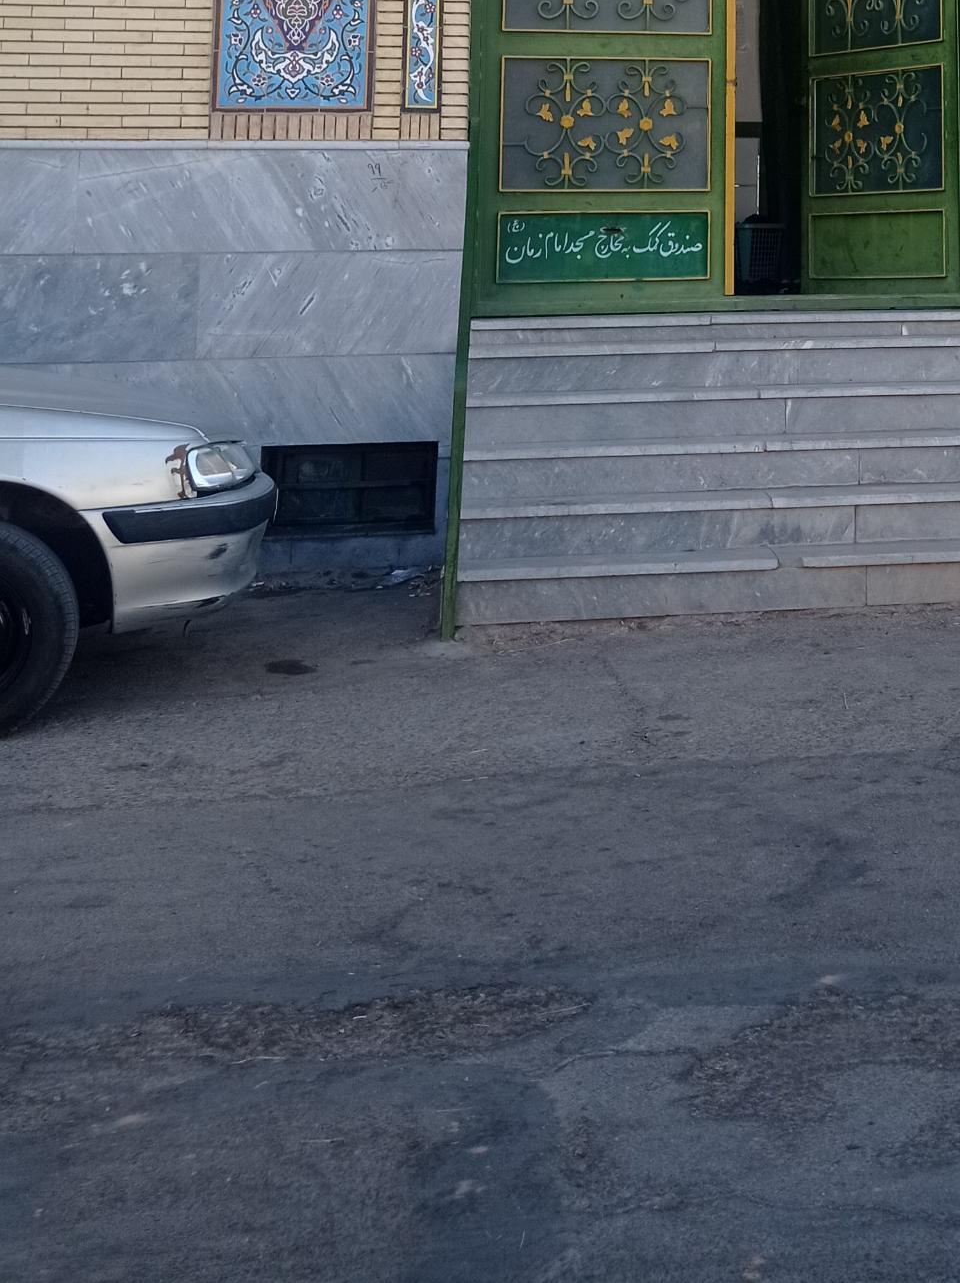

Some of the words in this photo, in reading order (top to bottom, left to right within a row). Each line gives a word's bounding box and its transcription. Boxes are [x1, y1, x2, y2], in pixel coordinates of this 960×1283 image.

[505, 233, 542, 264] زمان
[544, 231, 569, 259] امام
[565, 230, 595, 259] مسجد
[632, 221, 672, 254] کمک
[659, 232, 703, 257] صندوق
[621, 245, 631, 259] به
